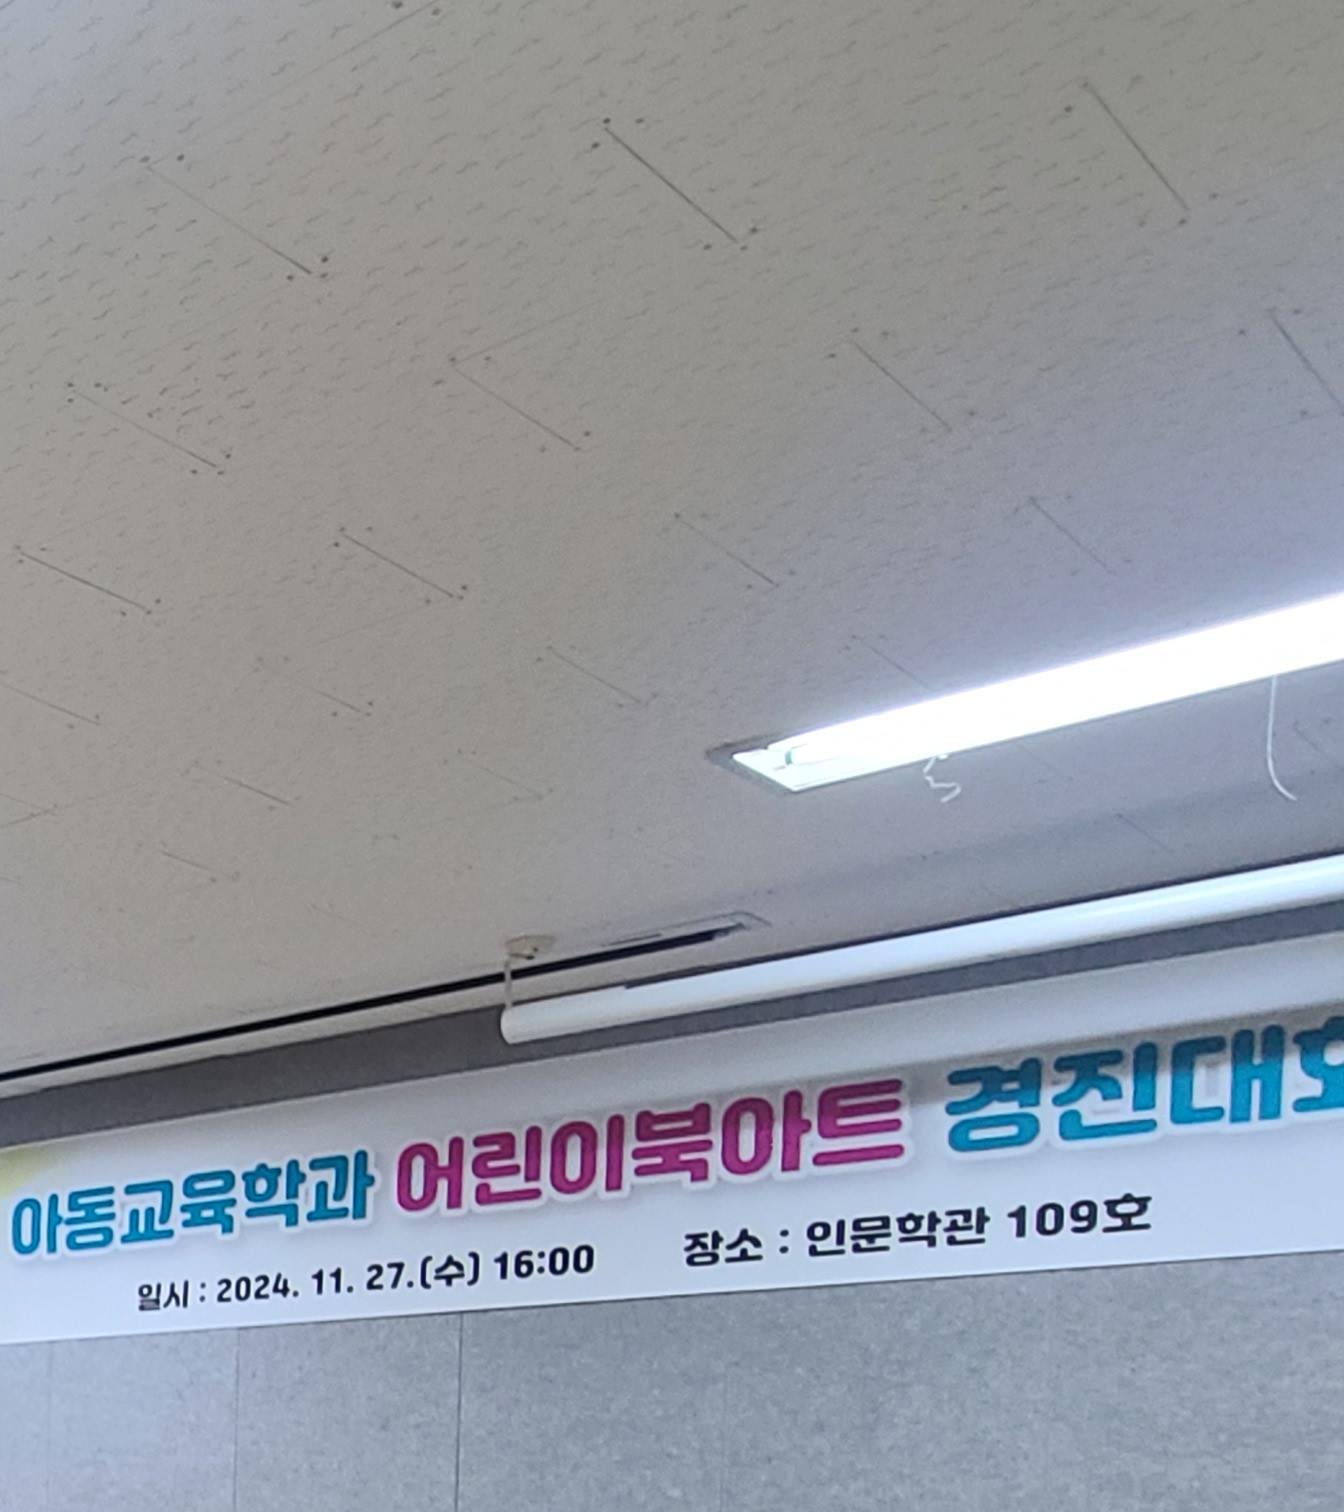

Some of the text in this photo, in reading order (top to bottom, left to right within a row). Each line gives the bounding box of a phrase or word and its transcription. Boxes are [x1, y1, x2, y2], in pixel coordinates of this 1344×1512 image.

[11, 1148, 376, 1256] 아동교육학과
[396, 1078, 905, 1212] 어린이북아트
[683, 1227, 764, 1267] 장소
[805, 1206, 991, 1258] 인문학관
[1007, 1193, 1153, 1239] 109호
[138, 1279, 189, 1312] 일시
[216, 1271, 300, 1303] 2024.
[311, 1267, 354, 1296] 11.
[366, 1251, 480, 1290] 27.(수)
[493, 1244, 595, 1280] 16:00
